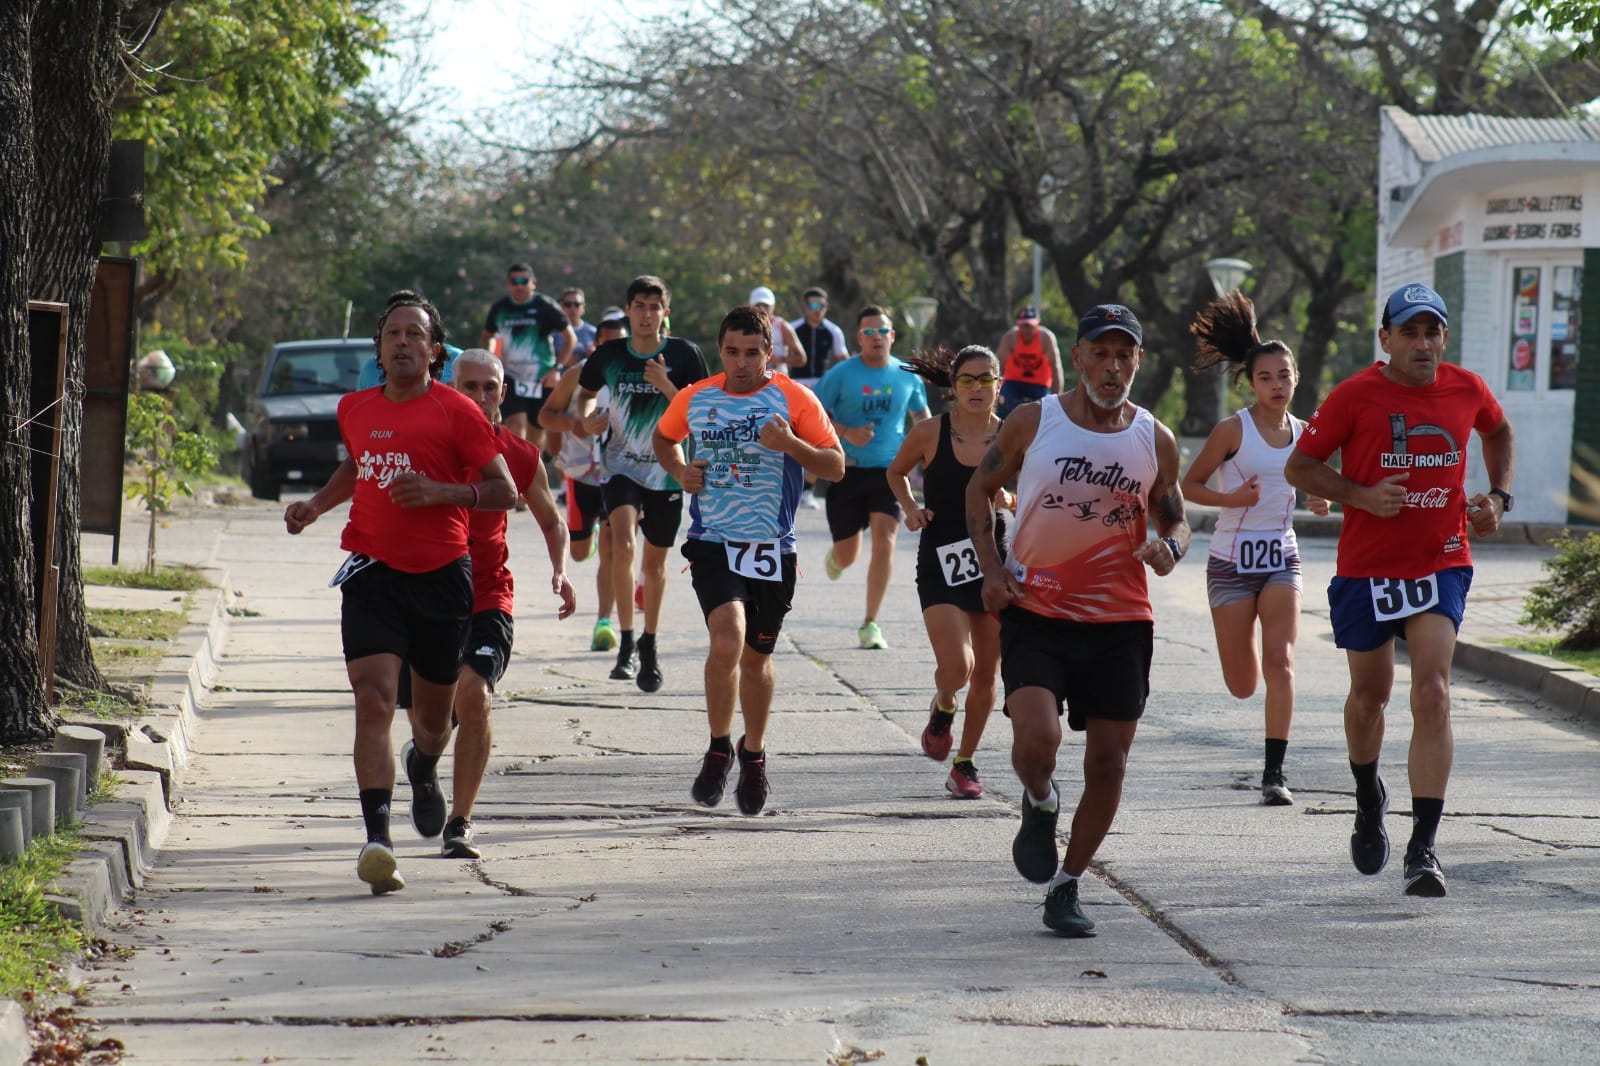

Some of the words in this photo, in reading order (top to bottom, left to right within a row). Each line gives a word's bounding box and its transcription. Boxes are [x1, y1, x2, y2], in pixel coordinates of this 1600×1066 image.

[369, 430, 394, 439] RUN
[1381, 453, 1413, 468] HALF
[1415, 454, 1444, 468] IRON
[727, 541, 777, 577] 75
[945, 547, 980, 584] 23
[1240, 539, 1282, 570] 026
[1373, 578, 1433, 616] 36
